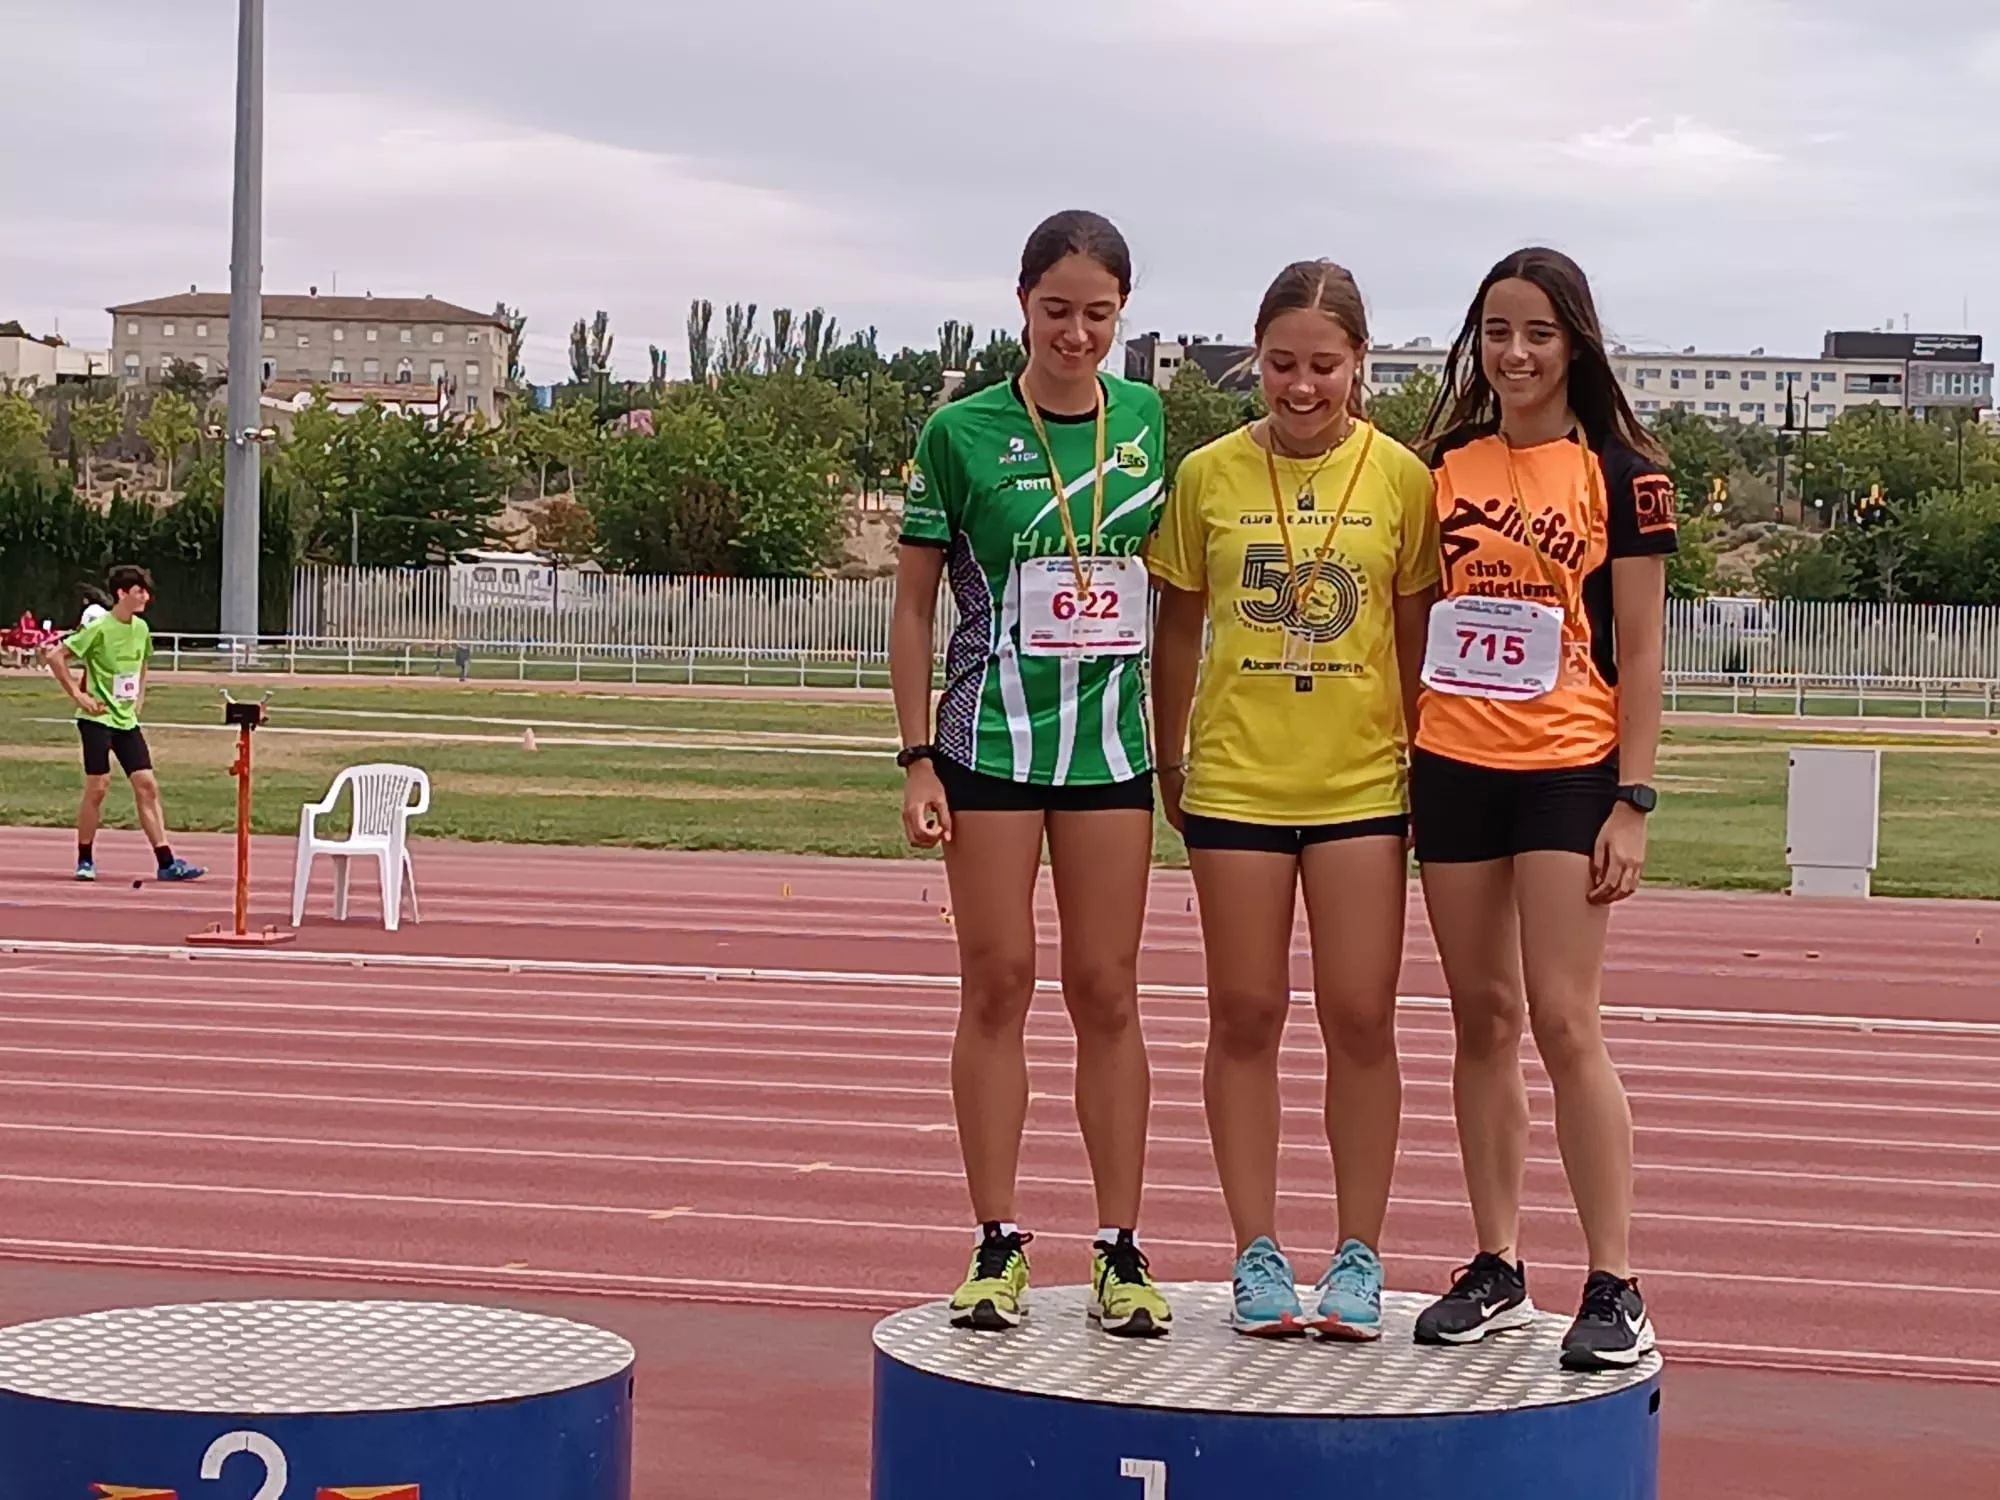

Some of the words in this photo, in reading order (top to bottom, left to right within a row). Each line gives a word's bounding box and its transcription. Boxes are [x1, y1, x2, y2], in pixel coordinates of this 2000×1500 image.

[1012, 529, 1144, 558] Huesca
[1465, 560, 1512, 577] club
[1052, 590, 1119, 620] 622
[1241, 543, 1360, 643] 50
[1455, 629, 1526, 666] 715
